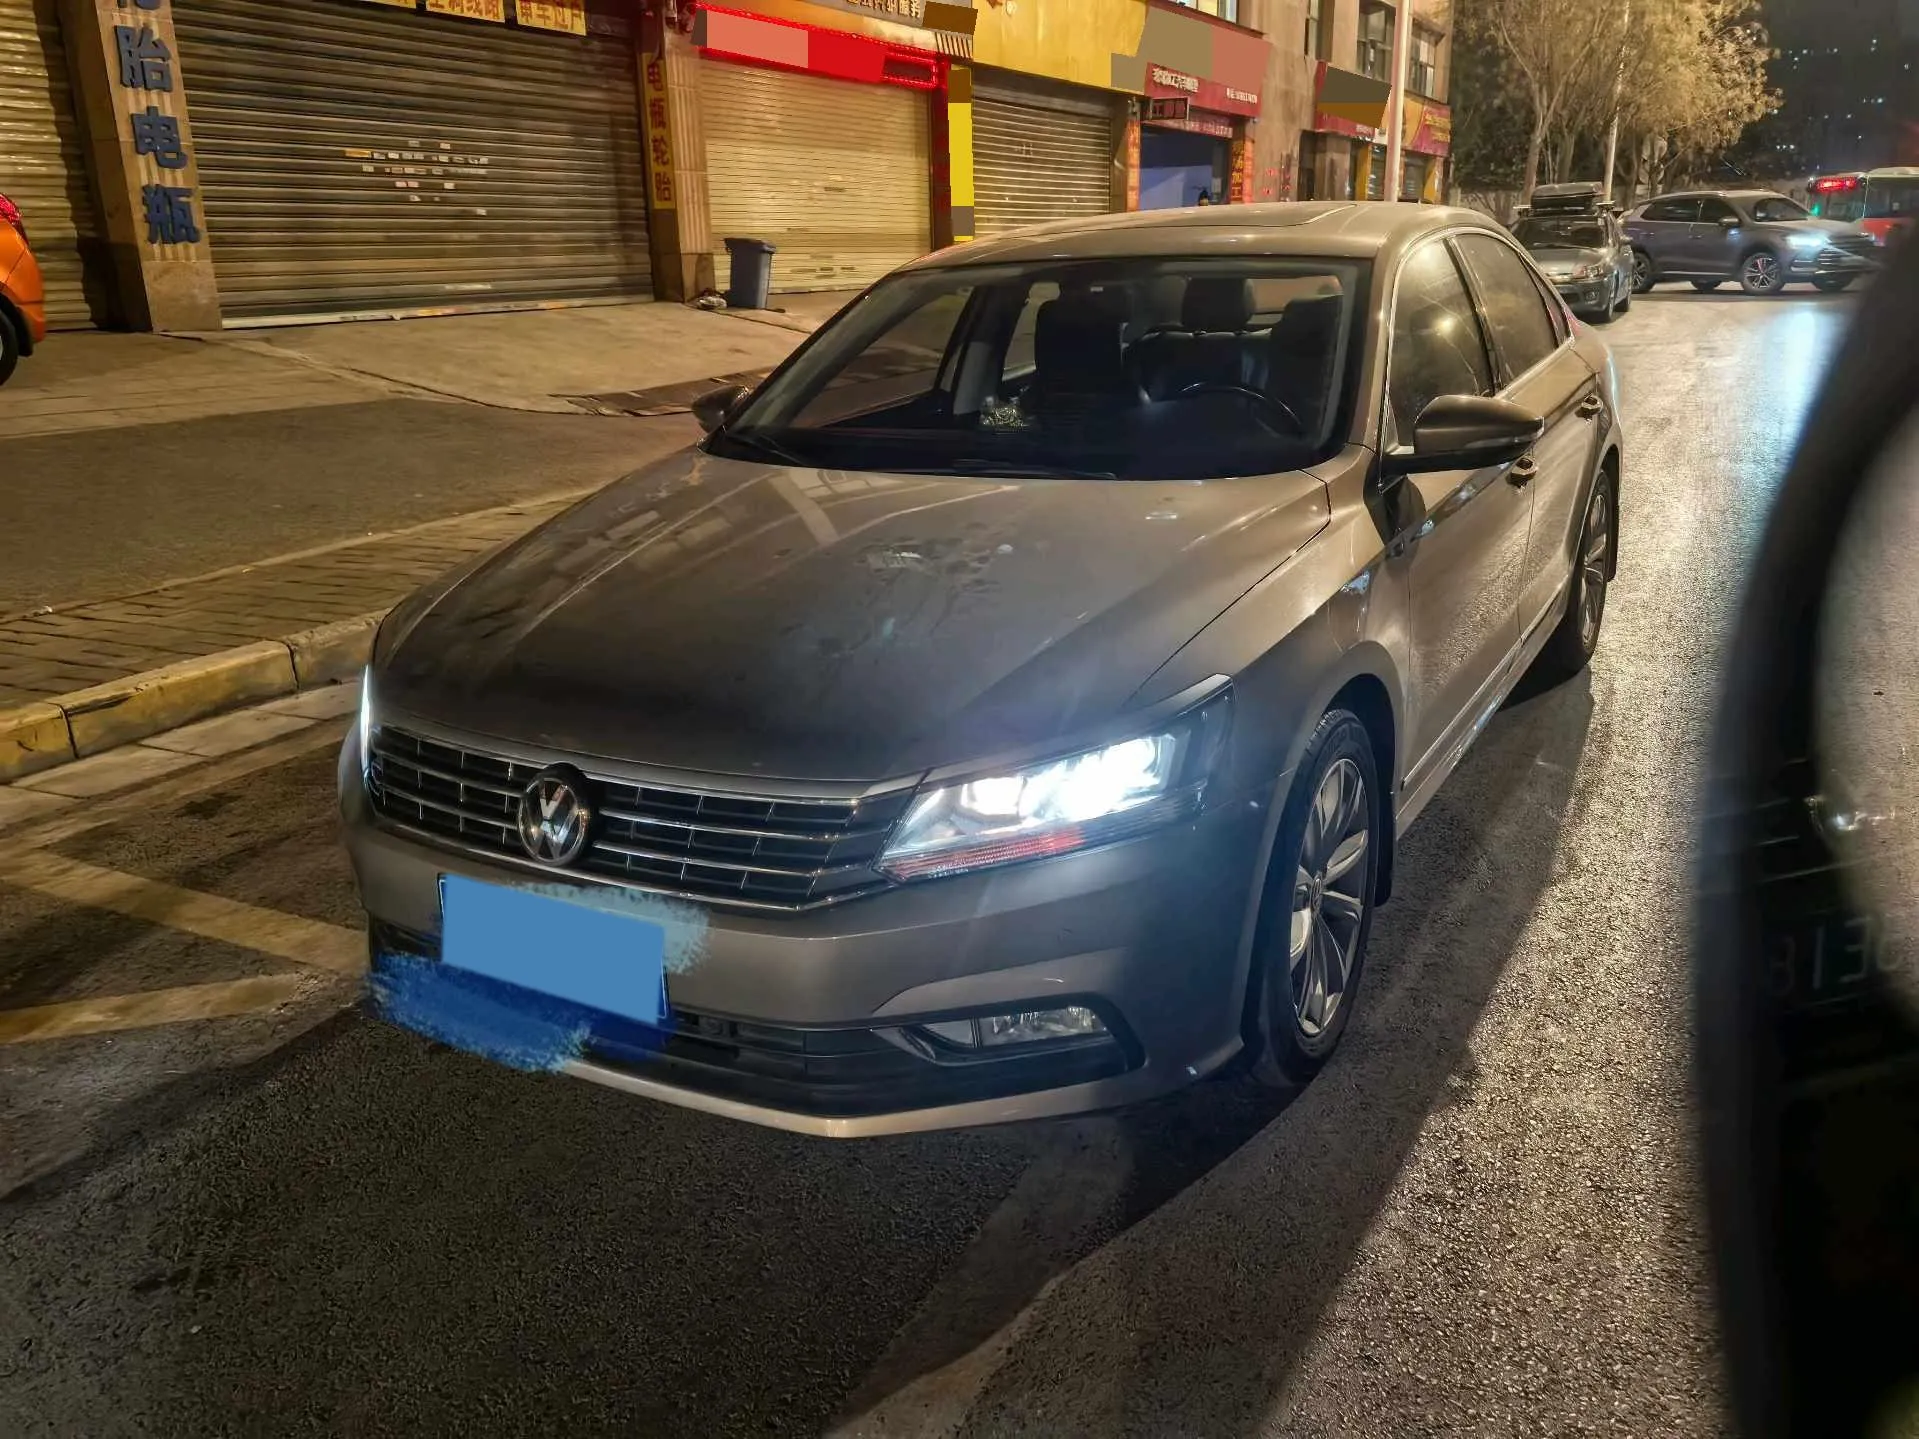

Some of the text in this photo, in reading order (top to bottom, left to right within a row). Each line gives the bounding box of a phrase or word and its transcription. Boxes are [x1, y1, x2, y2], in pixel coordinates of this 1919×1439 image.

[116, 0, 201, 245] 胎电瓶
[646, 63, 672, 201] 电瓶轮胎
